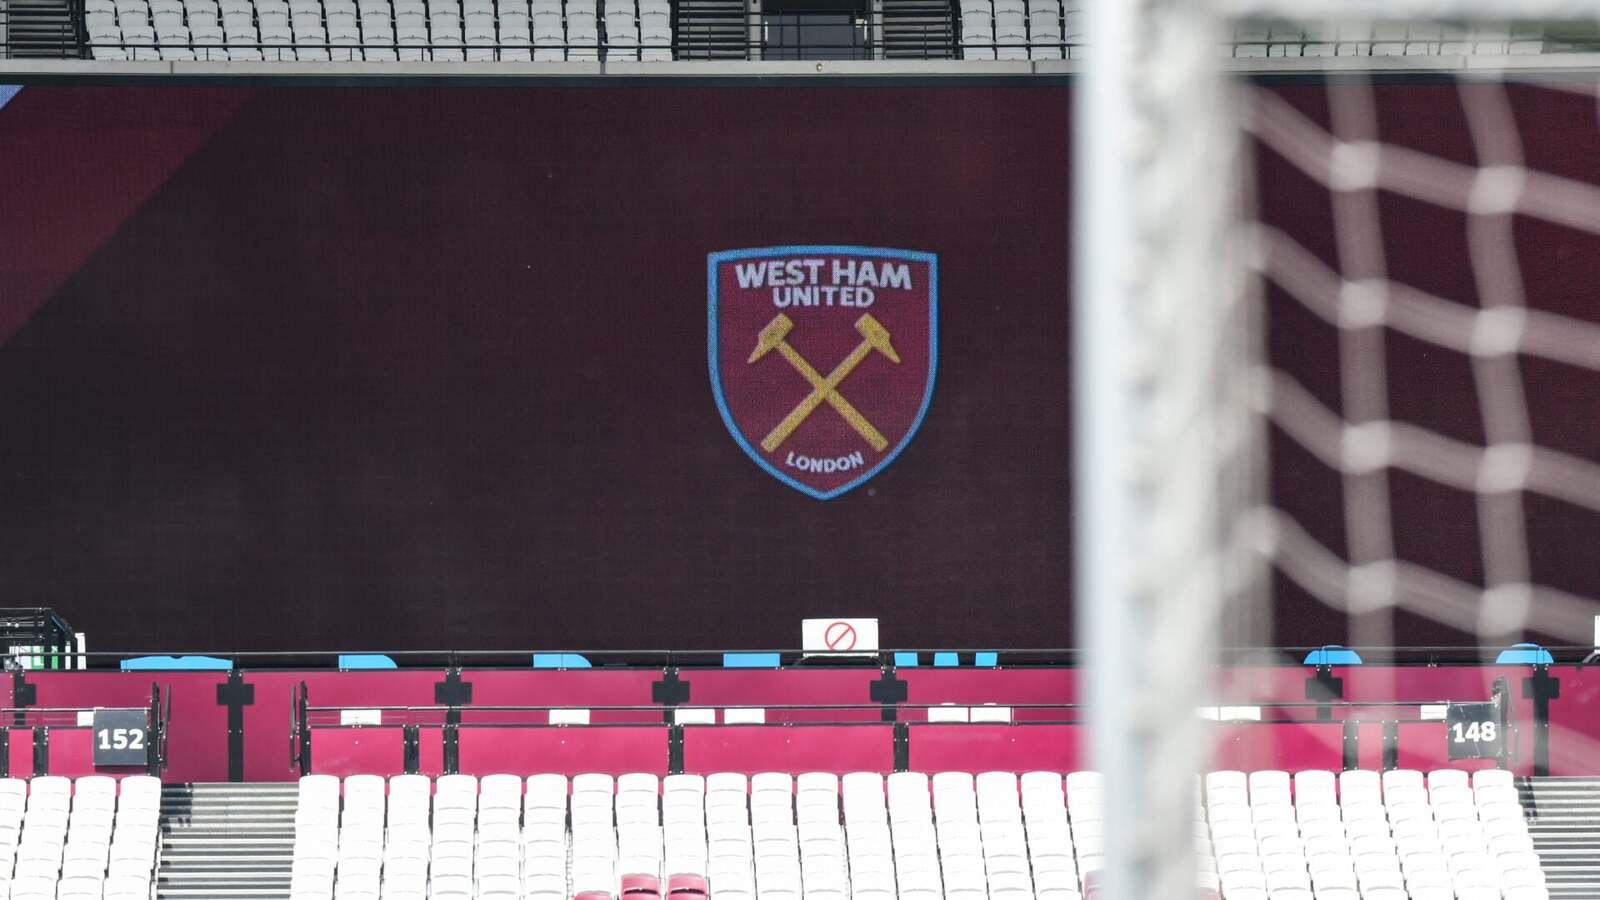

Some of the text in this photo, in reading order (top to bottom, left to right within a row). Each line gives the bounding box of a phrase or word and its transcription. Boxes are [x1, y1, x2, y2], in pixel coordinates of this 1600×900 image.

[735, 259, 912, 290] WEST HAM
[773, 286, 875, 308] UNITED
[785, 451, 864, 473] LONDON
[97, 728, 144, 750] 152
[1452, 721, 1496, 743] 148
